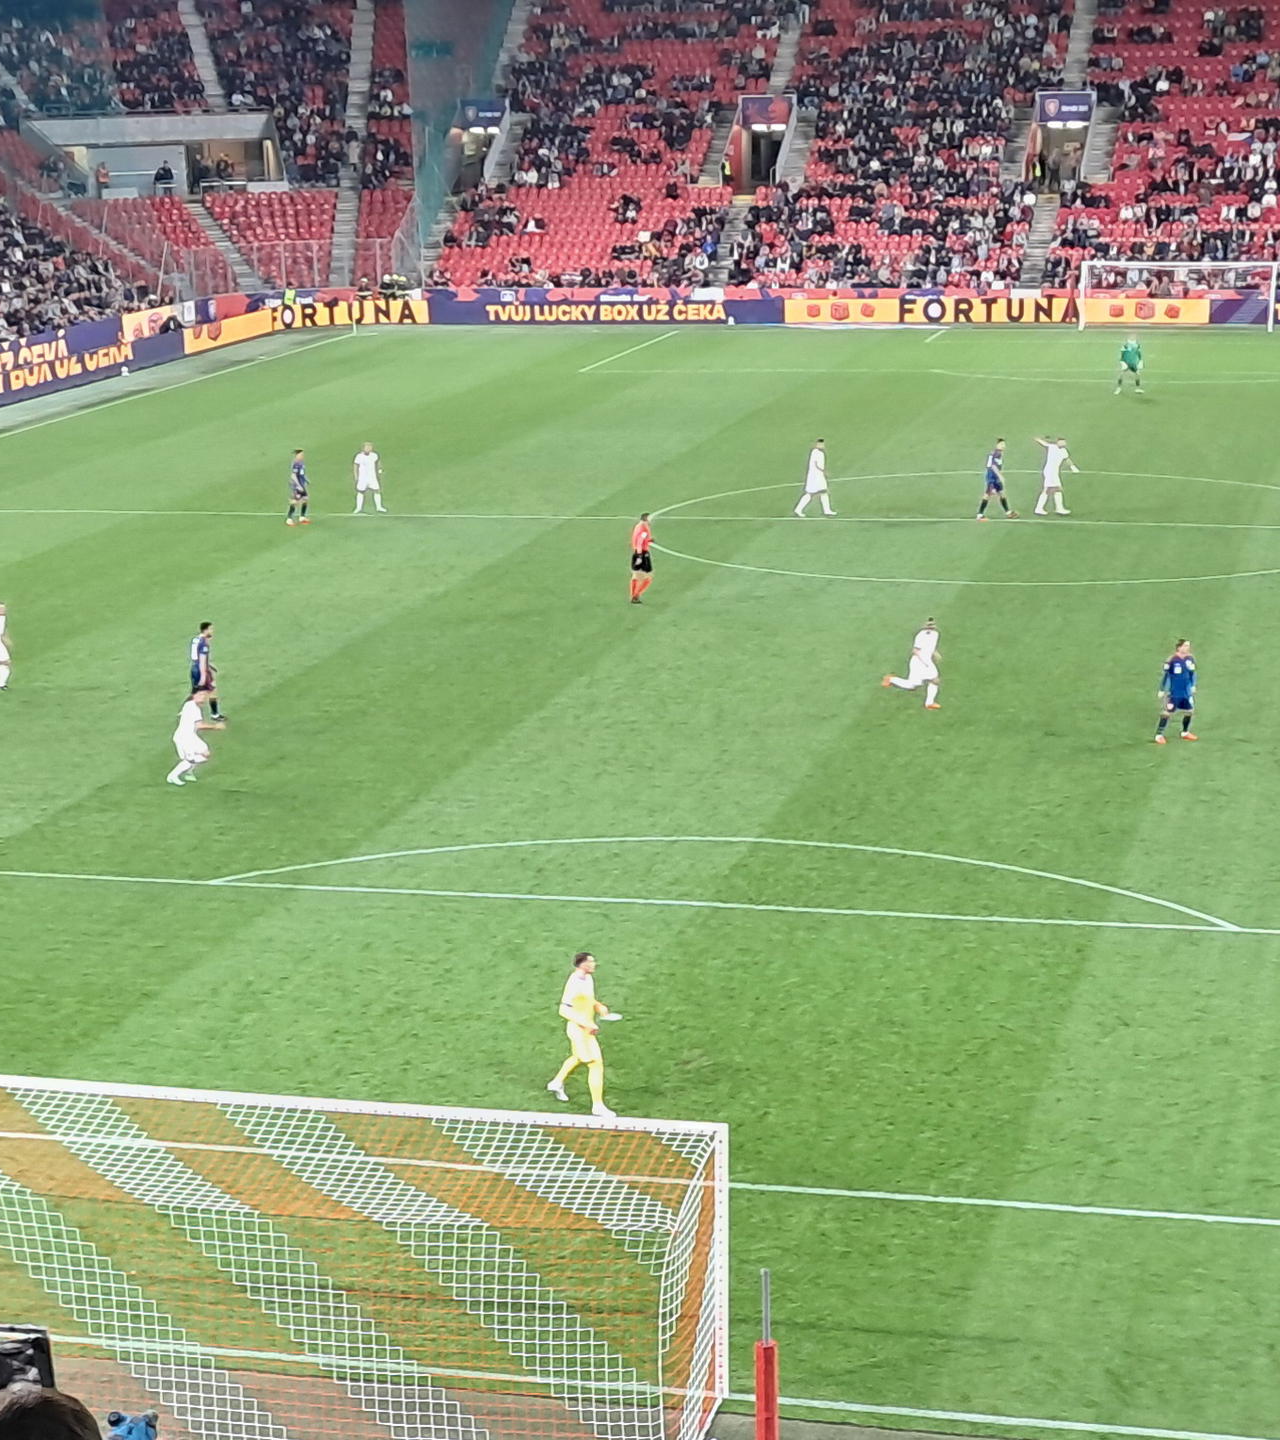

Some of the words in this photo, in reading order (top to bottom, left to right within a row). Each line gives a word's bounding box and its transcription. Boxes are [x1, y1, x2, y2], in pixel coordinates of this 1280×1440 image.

[270, 297, 418, 331] FORTUNA
[533, 304, 597, 321] LUCKY
[599, 304, 641, 321] BOX
[642, 300, 669, 321] UŽ
[898, 296, 1080, 323] FORTUNA
